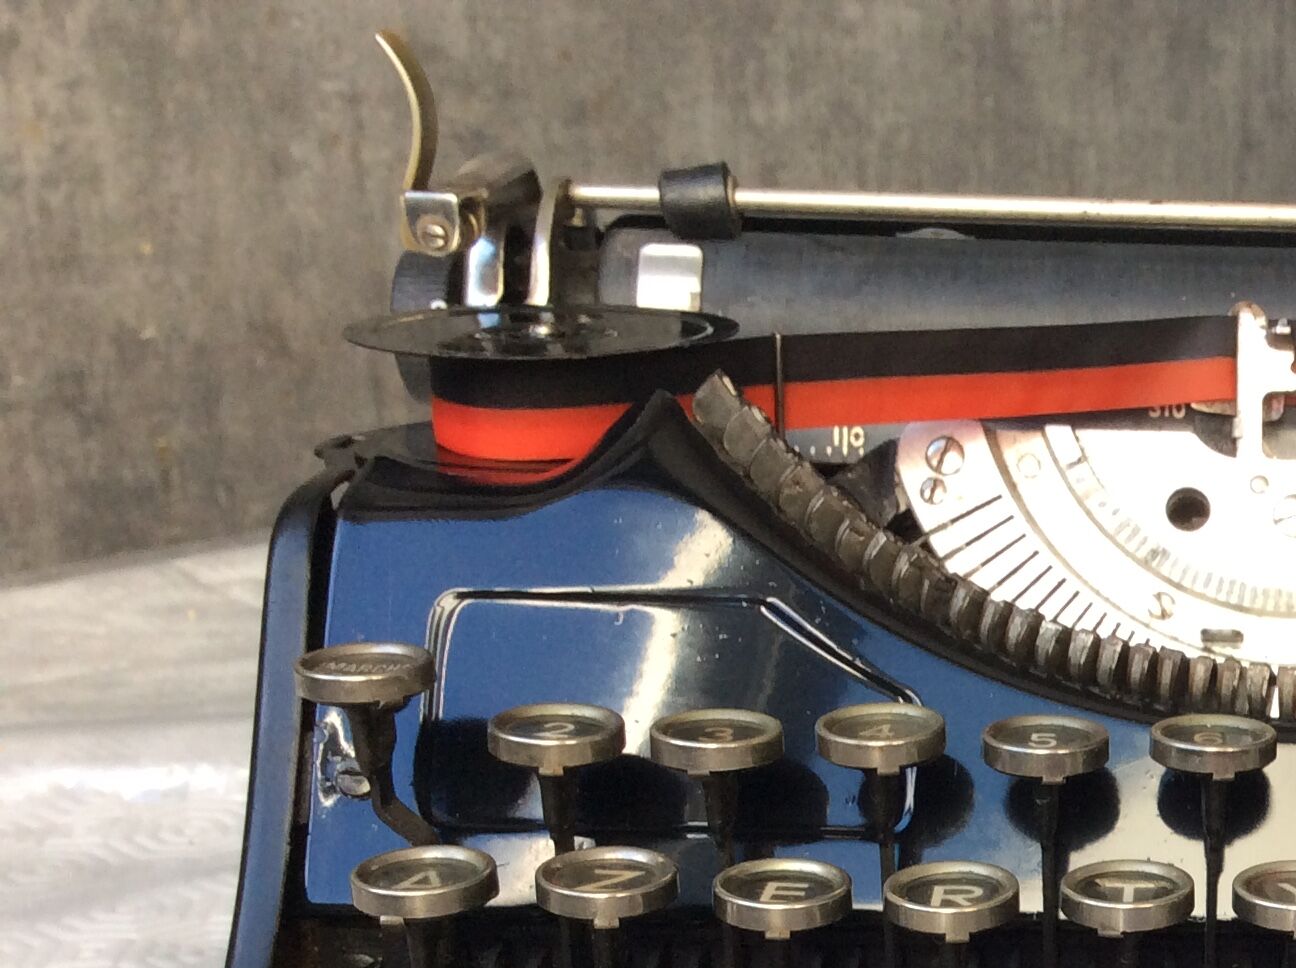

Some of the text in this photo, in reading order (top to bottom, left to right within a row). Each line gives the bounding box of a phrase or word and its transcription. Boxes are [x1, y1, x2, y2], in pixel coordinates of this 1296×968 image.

[541, 723, 574, 739] 2
[701, 727, 734, 743] 3
[859, 724, 895, 739] 4
[1027, 732, 1057, 748] 5
[1193, 731, 1223, 746] 6
[392, 868, 441, 889] A
[575, 869, 646, 891] Z
[759, 882, 809, 902] E
[930, 884, 984, 907] R
[1105, 883, 1155, 903] T
